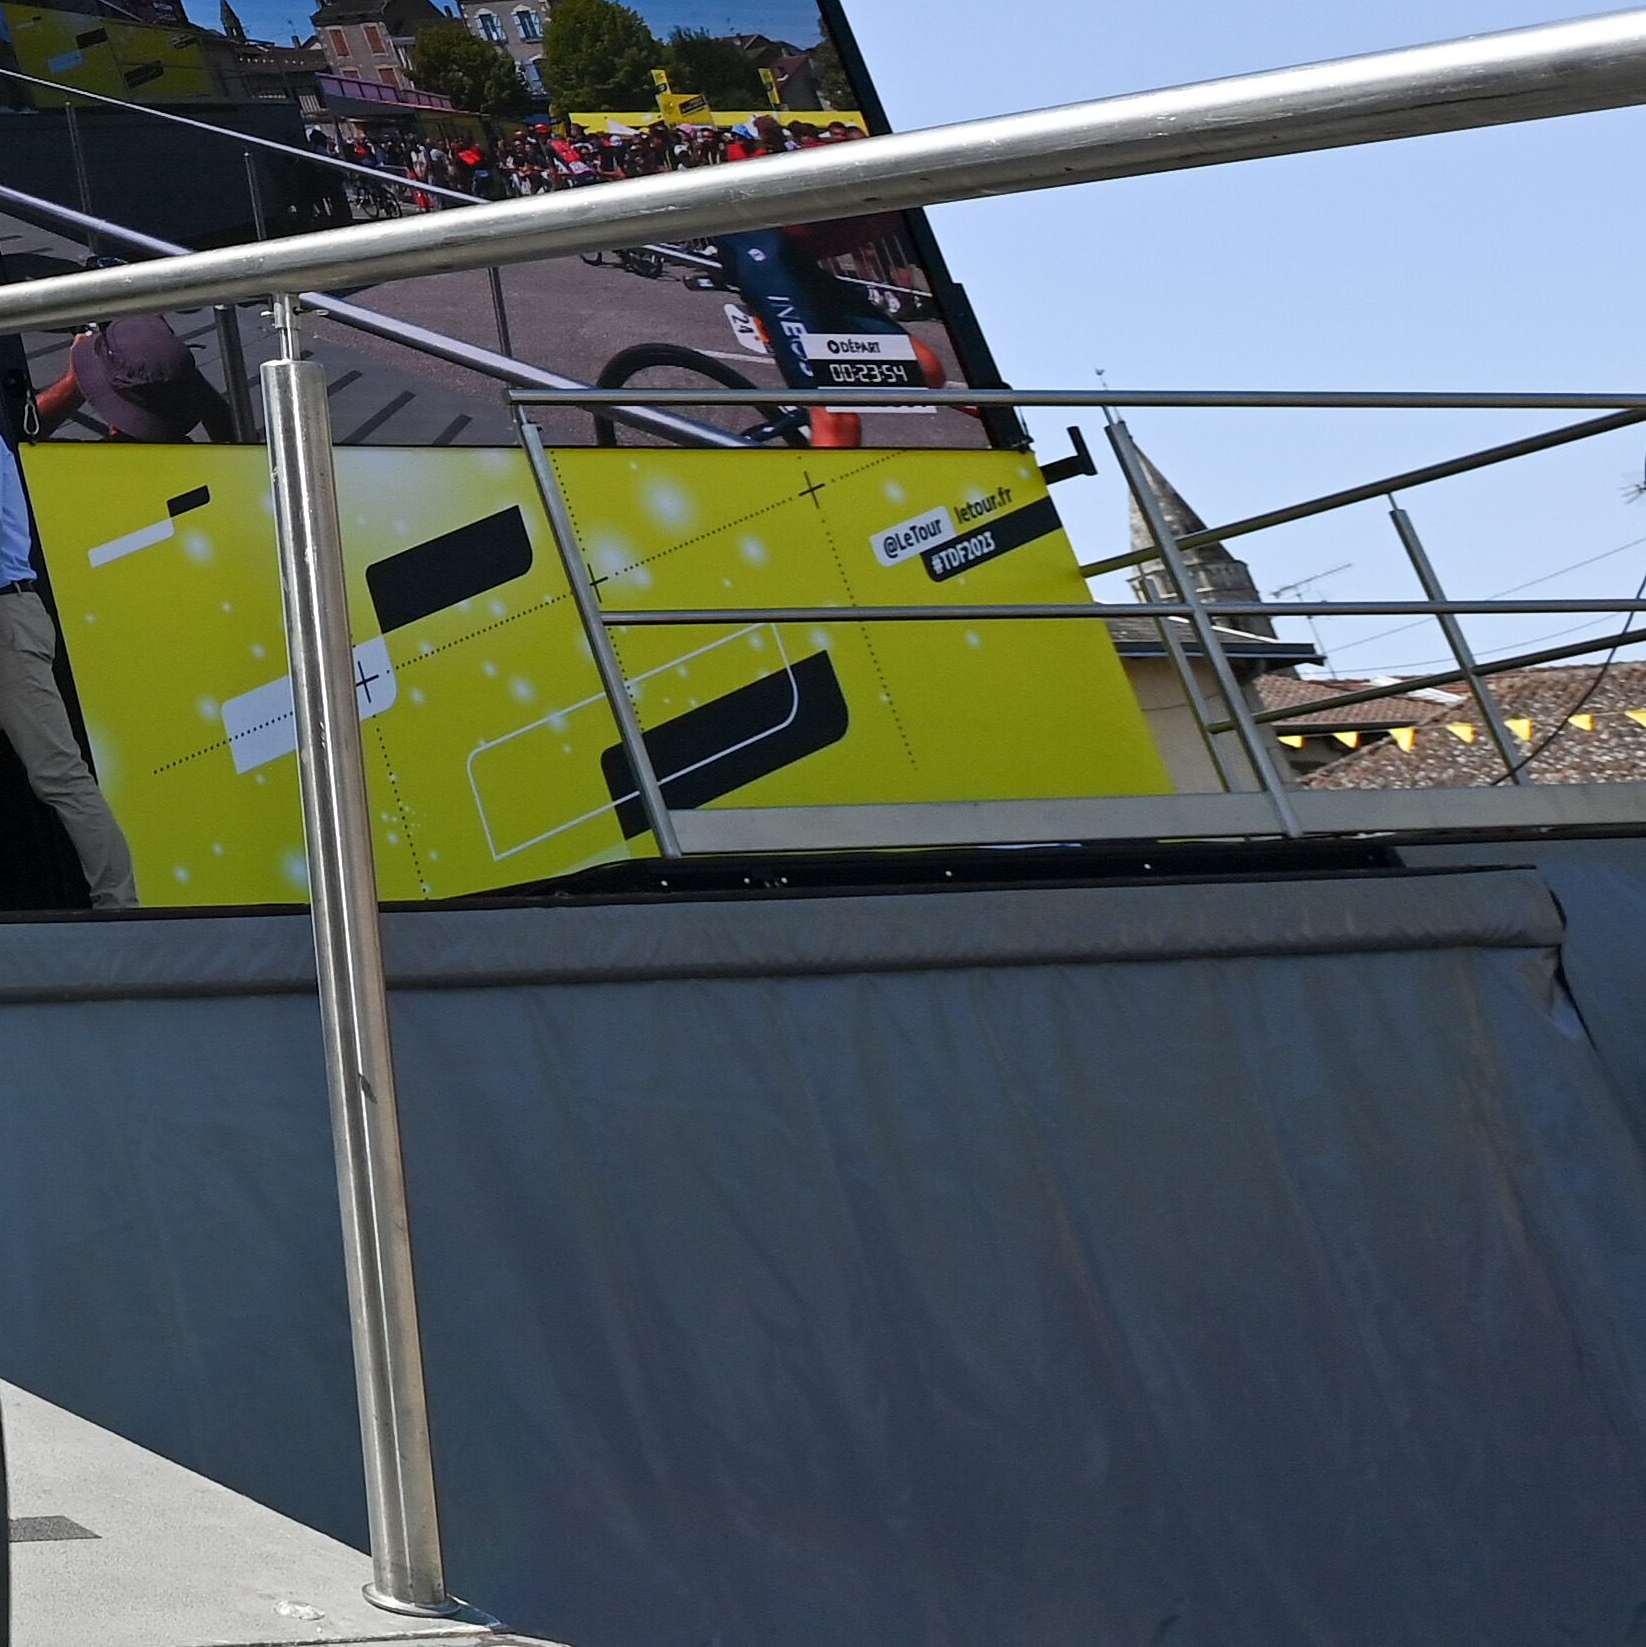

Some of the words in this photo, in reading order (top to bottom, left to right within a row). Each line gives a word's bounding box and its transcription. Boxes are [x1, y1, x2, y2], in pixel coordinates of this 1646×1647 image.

[840, 338, 882, 355] DÉPART
[829, 363, 909, 383] 00:23:54
[953, 486, 1013, 525] letour.fr
[882, 518, 942, 559] @LeTour
[931, 530, 996, 575] #TDF2023
